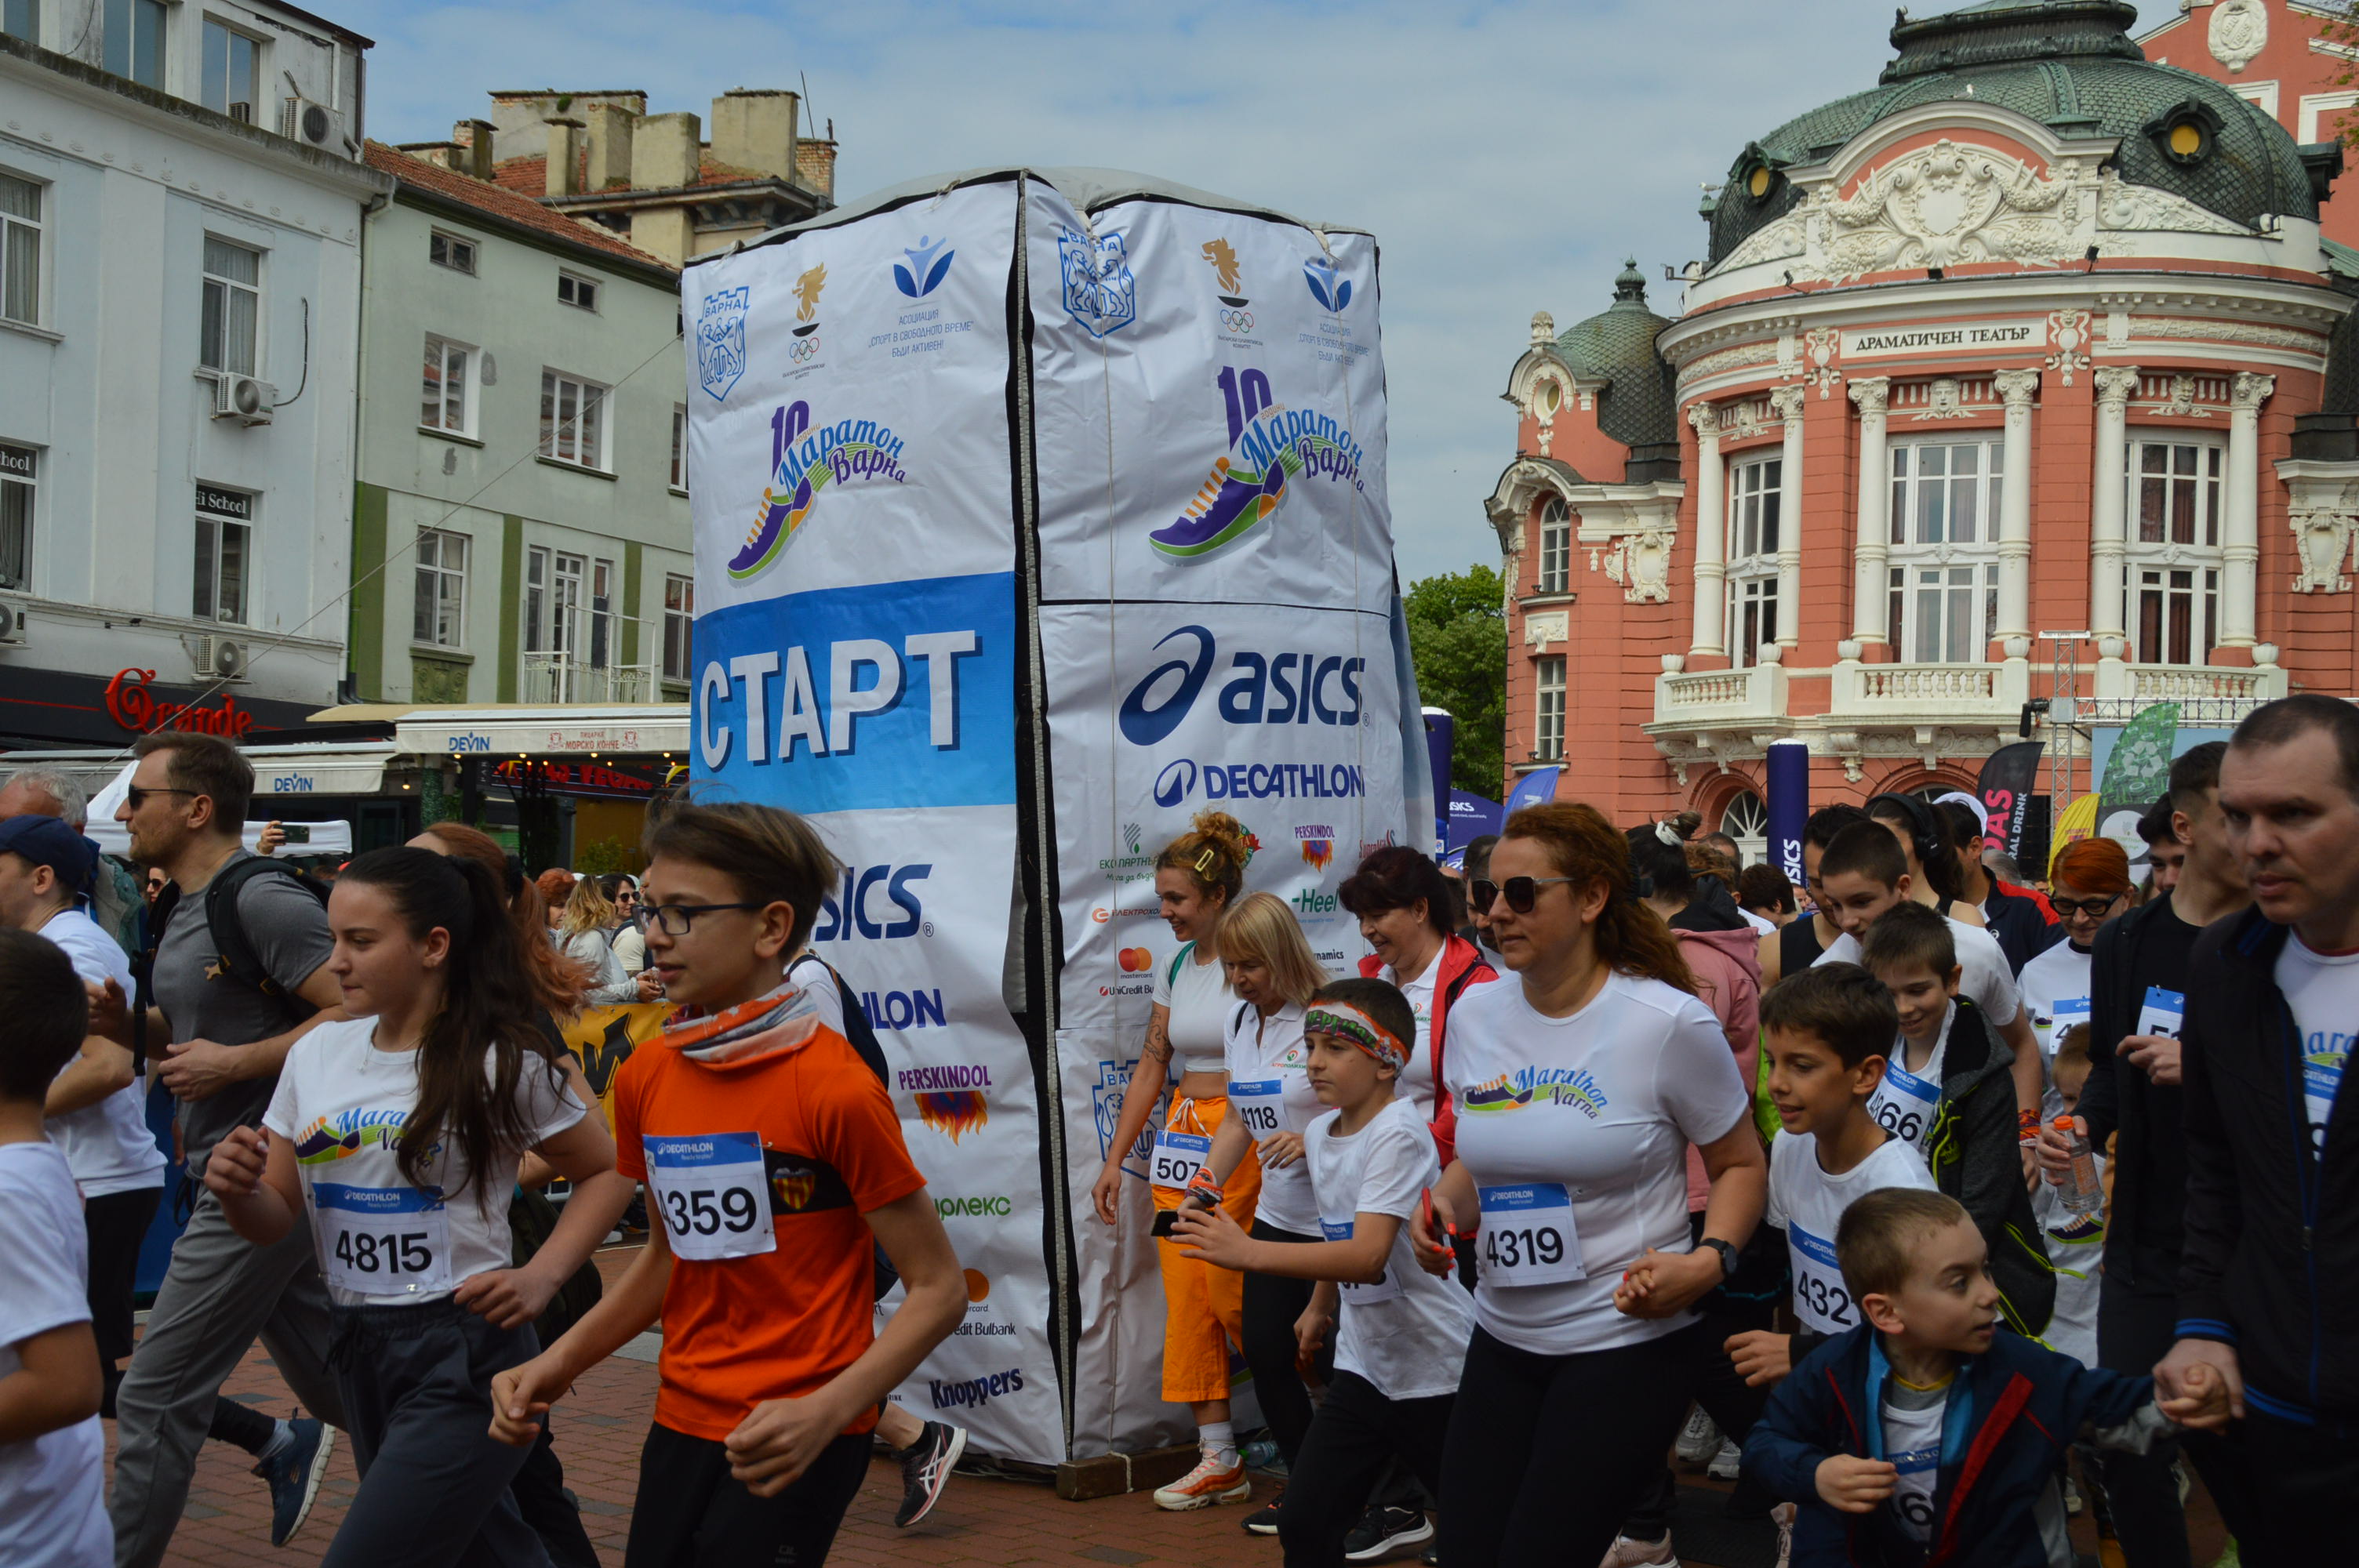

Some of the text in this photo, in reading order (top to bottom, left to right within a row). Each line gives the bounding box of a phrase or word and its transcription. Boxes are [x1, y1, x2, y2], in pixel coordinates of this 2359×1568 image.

[1069, 232, 1118, 252] ВАНА
[706, 299, 741, 318] ВАРНА
[899, 310, 939, 325] АСОЦИАЦИЯ
[893, 332, 898, 343] В
[900, 324, 943, 342] СВОБОДНОТО
[1856, 327, 2030, 351] ДРАМАТИЧЕН ТЕАТЪР
[892, 345, 910, 358] БЪДИ
[1241, 408, 1363, 482] Маратон
[0, 452, 30, 470] hool
[779, 419, 904, 498] Маратон
[828, 447, 907, 486] Варна
[1298, 437, 1365, 493] Варна
[208, 492, 246, 514] School
[700, 630, 978, 770] СТАРТ
[449, 734, 490, 752] DEVIN
[565, 740, 594, 750] МОРСКО
[274, 774, 313, 793] DEVIN
[1202, 764, 1365, 799] DECATHLON
[2012, 793, 2027, 834] DRINK
[1294, 824, 1336, 839] PERSKINDOL
[1783, 838, 1801, 886] SICS
[1109, 985, 1143, 996] UniCredit
[898, 1065, 991, 1091] PERSKINDOL
[1515, 1065, 1608, 1110] Marathon
[1548, 1085, 1598, 1120] Varna
[1241, 1106, 1278, 1130] 4118
[666, 1142, 714, 1154] DECATHLON
[353, 1192, 401, 1201] DECATHLON
[1496, 1189, 1534, 1200] DECATHLON
[336, 1229, 432, 1274] 4815
[1486, 1227, 1564, 1268] 4319
[975, 1322, 1016, 1336] Bulbank
[929, 1368, 1024, 1410] Knoppers
